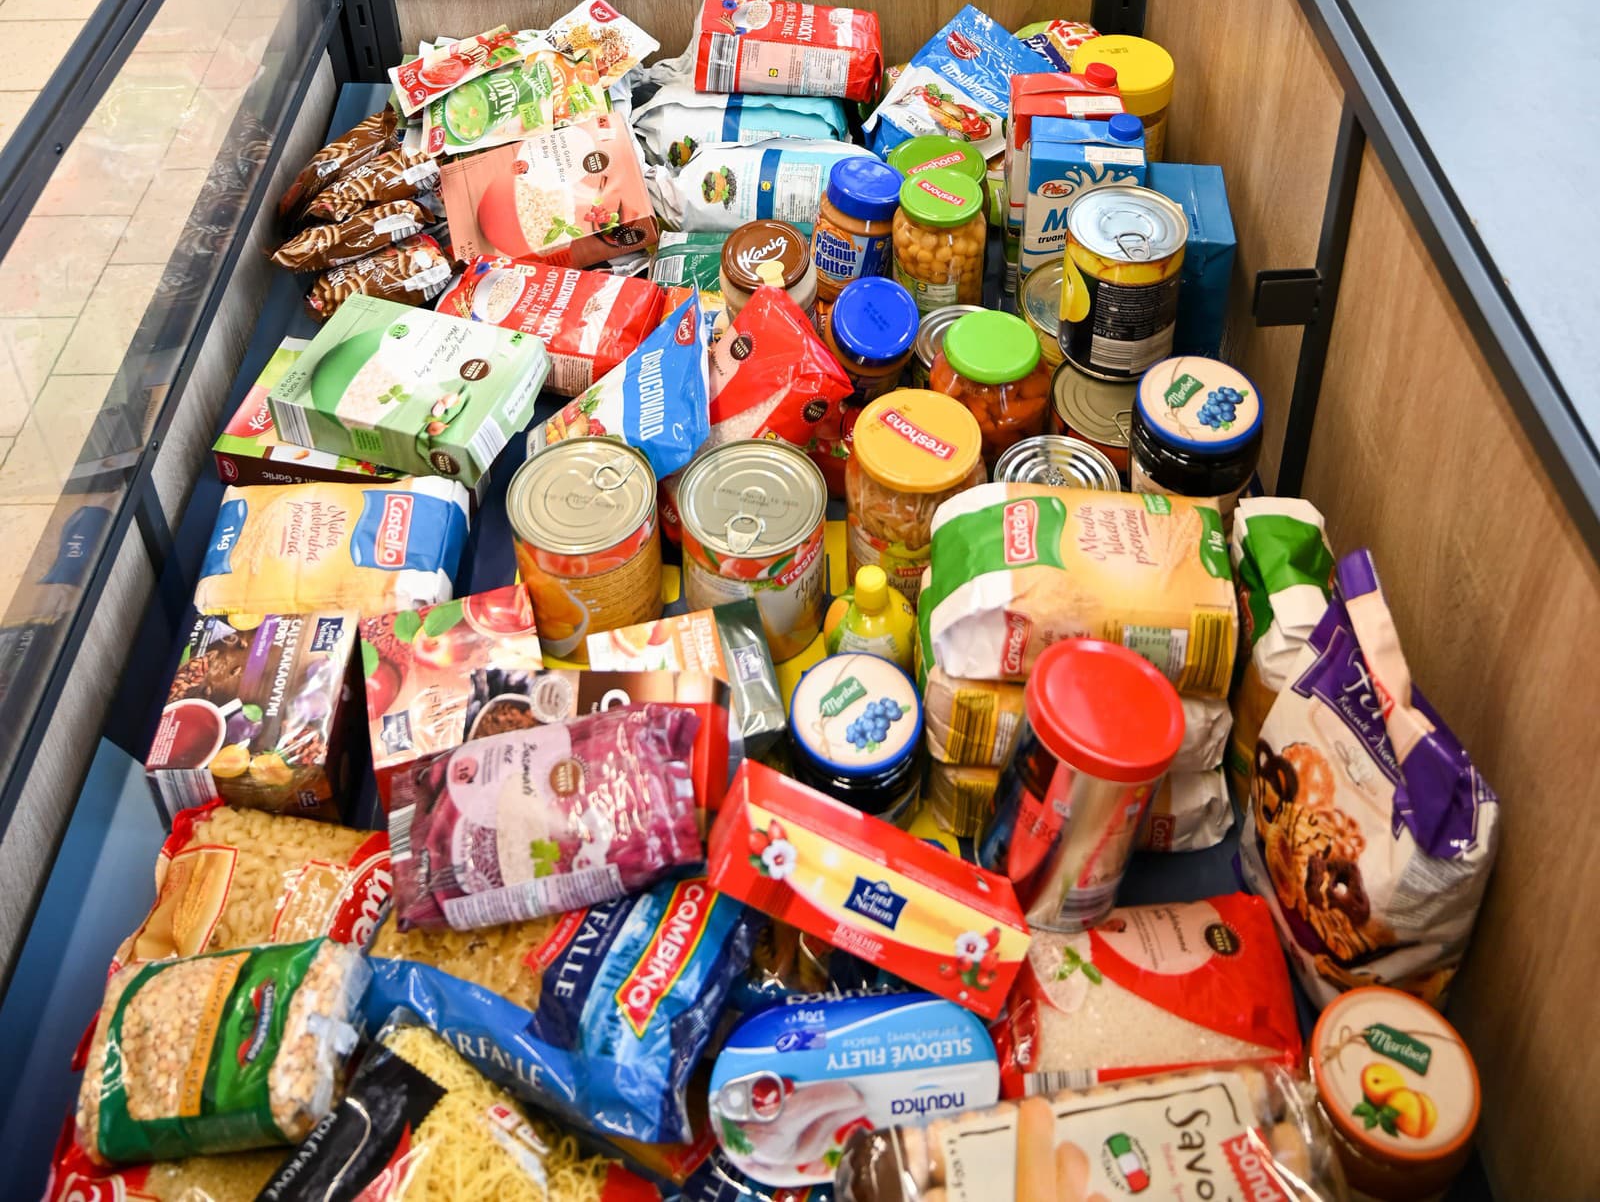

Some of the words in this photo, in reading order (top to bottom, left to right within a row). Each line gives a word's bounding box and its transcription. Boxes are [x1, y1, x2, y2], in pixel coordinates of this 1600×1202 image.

[922, 182, 963, 205] Freshona
[815, 233, 857, 262] Peanut
[823, 230, 850, 249] Smooth
[815, 253, 854, 276] Butter
[636, 348, 665, 442] OCHUCOVADLO
[1169, 375, 1198, 407] Maribel
[886, 413, 950, 458] Freshona
[262, 471, 293, 483] Garlic
[384, 497, 409, 563] Castello
[822, 679, 860, 713] Maribel
[852, 894, 894, 922] Nelson
[863, 884, 894, 908] Lord
[628, 885, 705, 1010] COMBINO
[827, 1047, 886, 1071] FILETY
[893, 1037, 973, 1068] SLEĎOVÉ
[1372, 1027, 1430, 1064] Maribel
[891, 1091, 965, 1118] nautica
